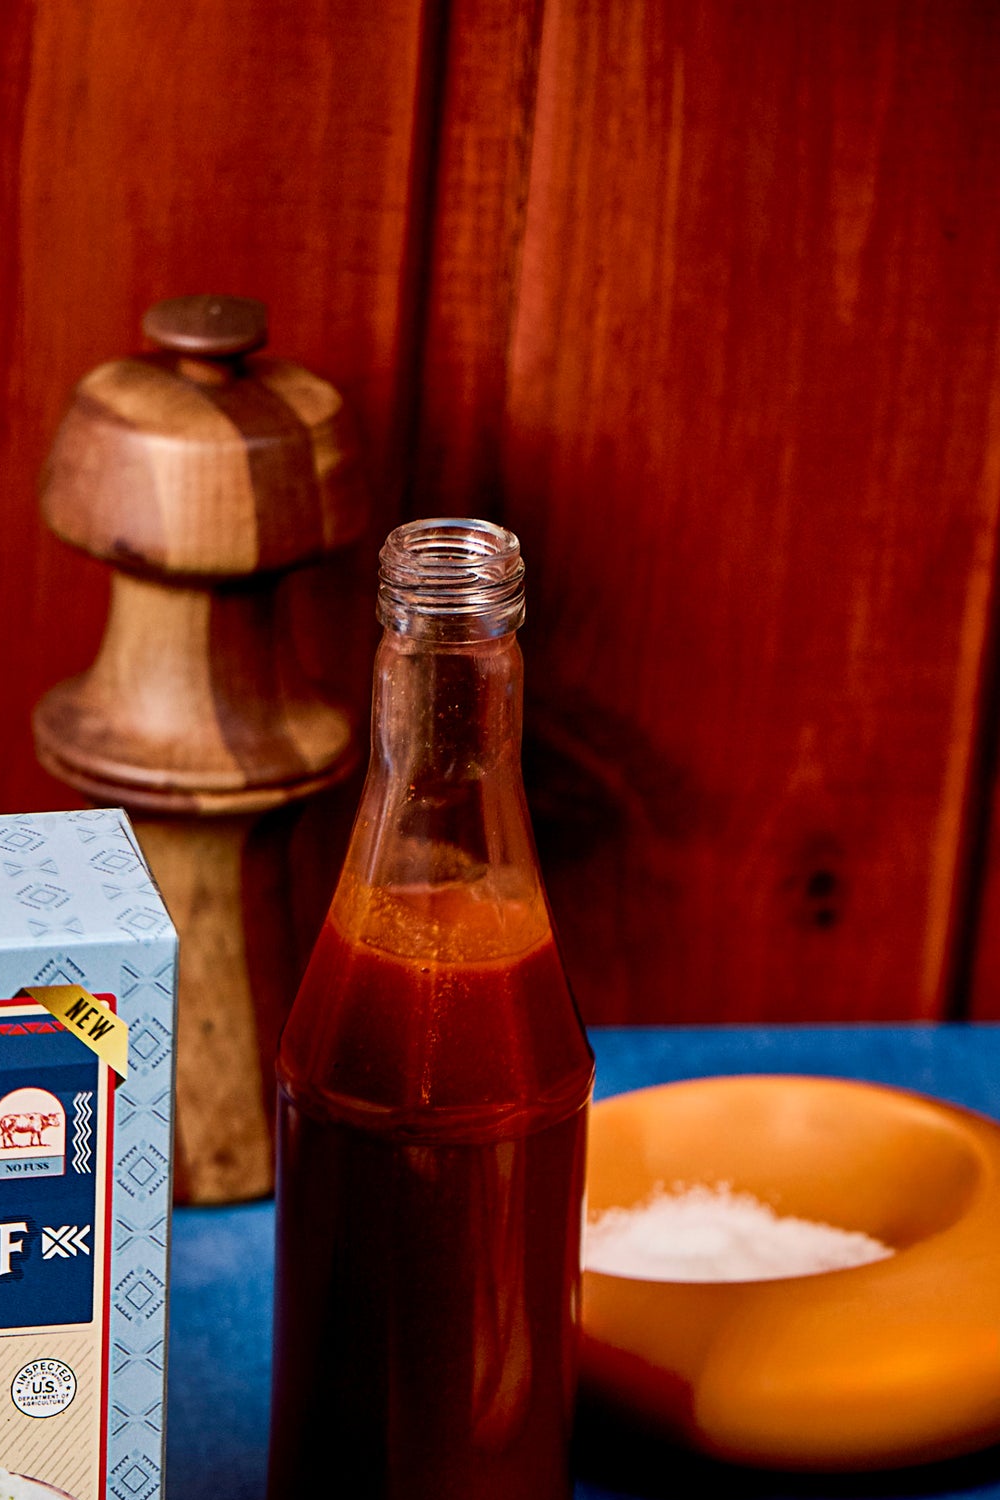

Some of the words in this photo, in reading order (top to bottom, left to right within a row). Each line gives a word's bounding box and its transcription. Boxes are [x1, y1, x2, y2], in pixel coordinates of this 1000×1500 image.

[64, 997, 115, 1041] NEW
[5, 1164, 22, 1173] NO
[23, 1161, 50, 1172] FUSS
[16, 1362, 72, 1385] INSPECTED
[32, 1380, 58, 1394] U.S.
